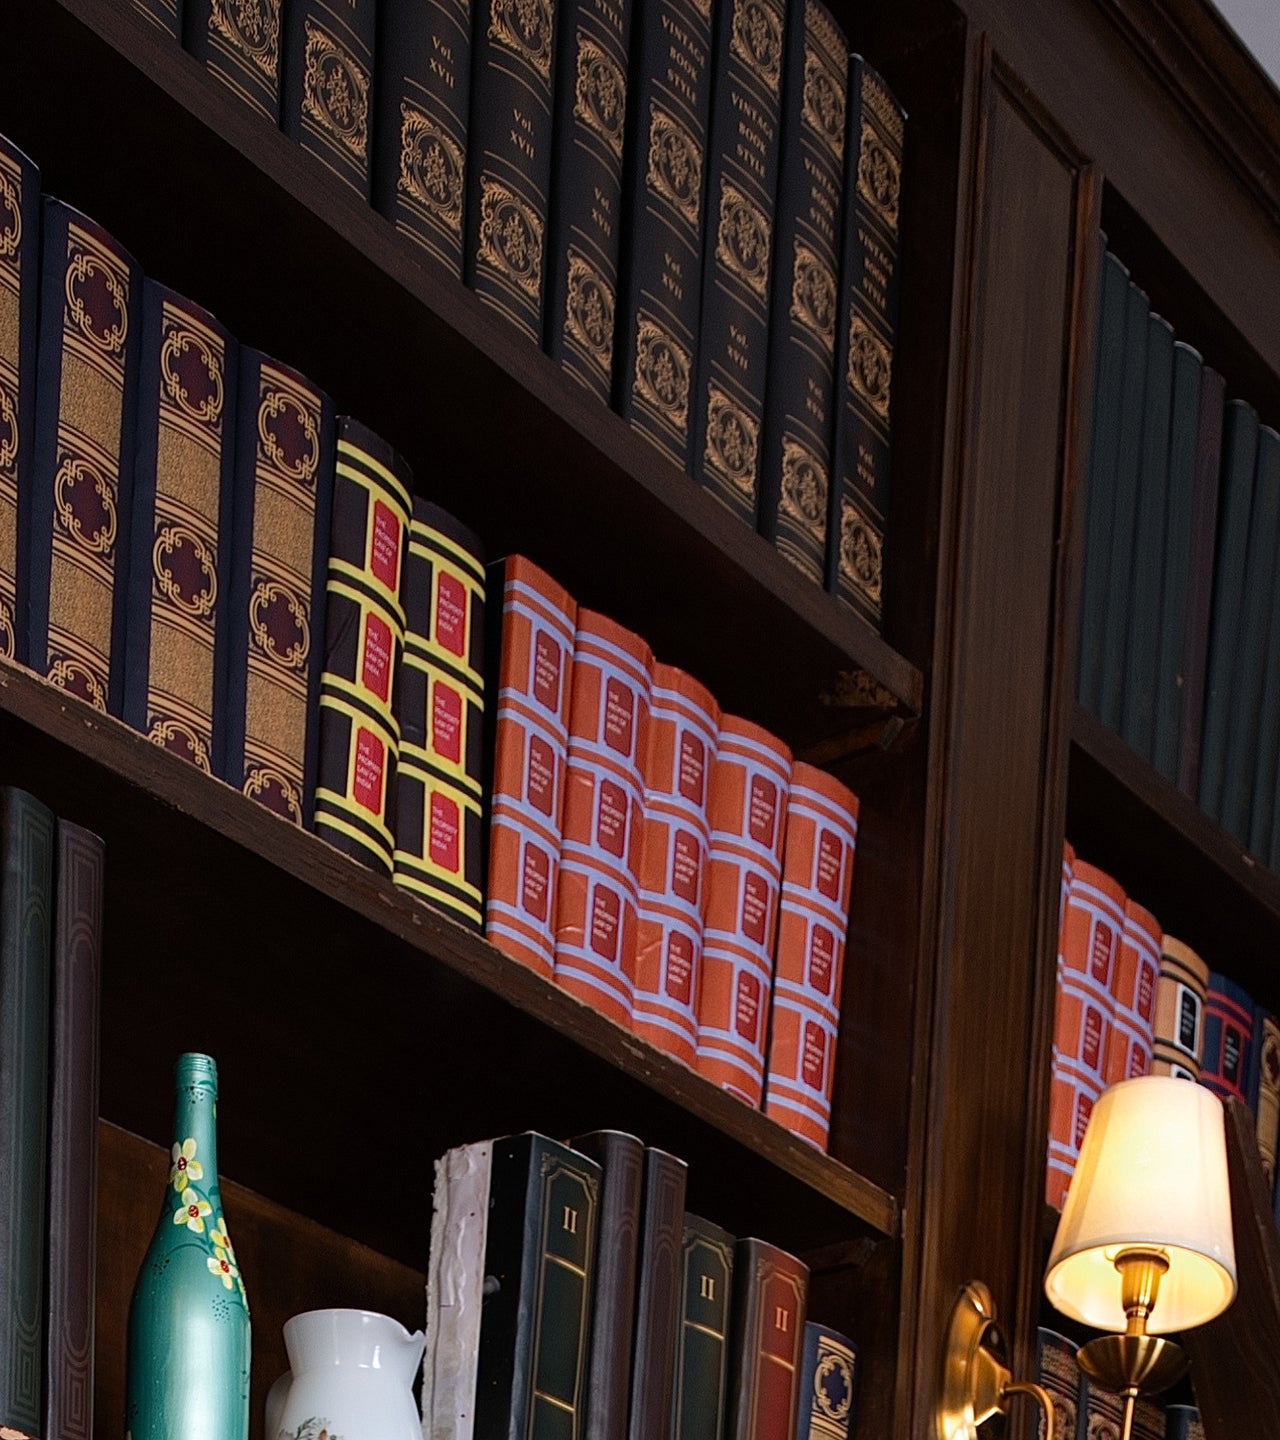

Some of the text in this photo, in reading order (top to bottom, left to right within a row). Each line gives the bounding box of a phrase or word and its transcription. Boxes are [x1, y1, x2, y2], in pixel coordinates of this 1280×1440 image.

[661, 14, 705, 69] VINTAGE
[429, 57, 454, 88] XVII
[669, 46, 697, 83] BOOK
[667, 68, 696, 106] STYLE
[731, 91, 773, 142] VINTAGE
[511, 130, 534, 160] XVII
[739, 121, 766, 156] BOOK
[736, 143, 765, 178] STYLE
[592, 208, 611, 237] XVII
[662, 272, 683, 300] XVII
[727, 344, 748, 370] XVII
[563, 1206, 577, 1234] II
[700, 1275, 714, 1301] II
[775, 1306, 788, 1332] II
